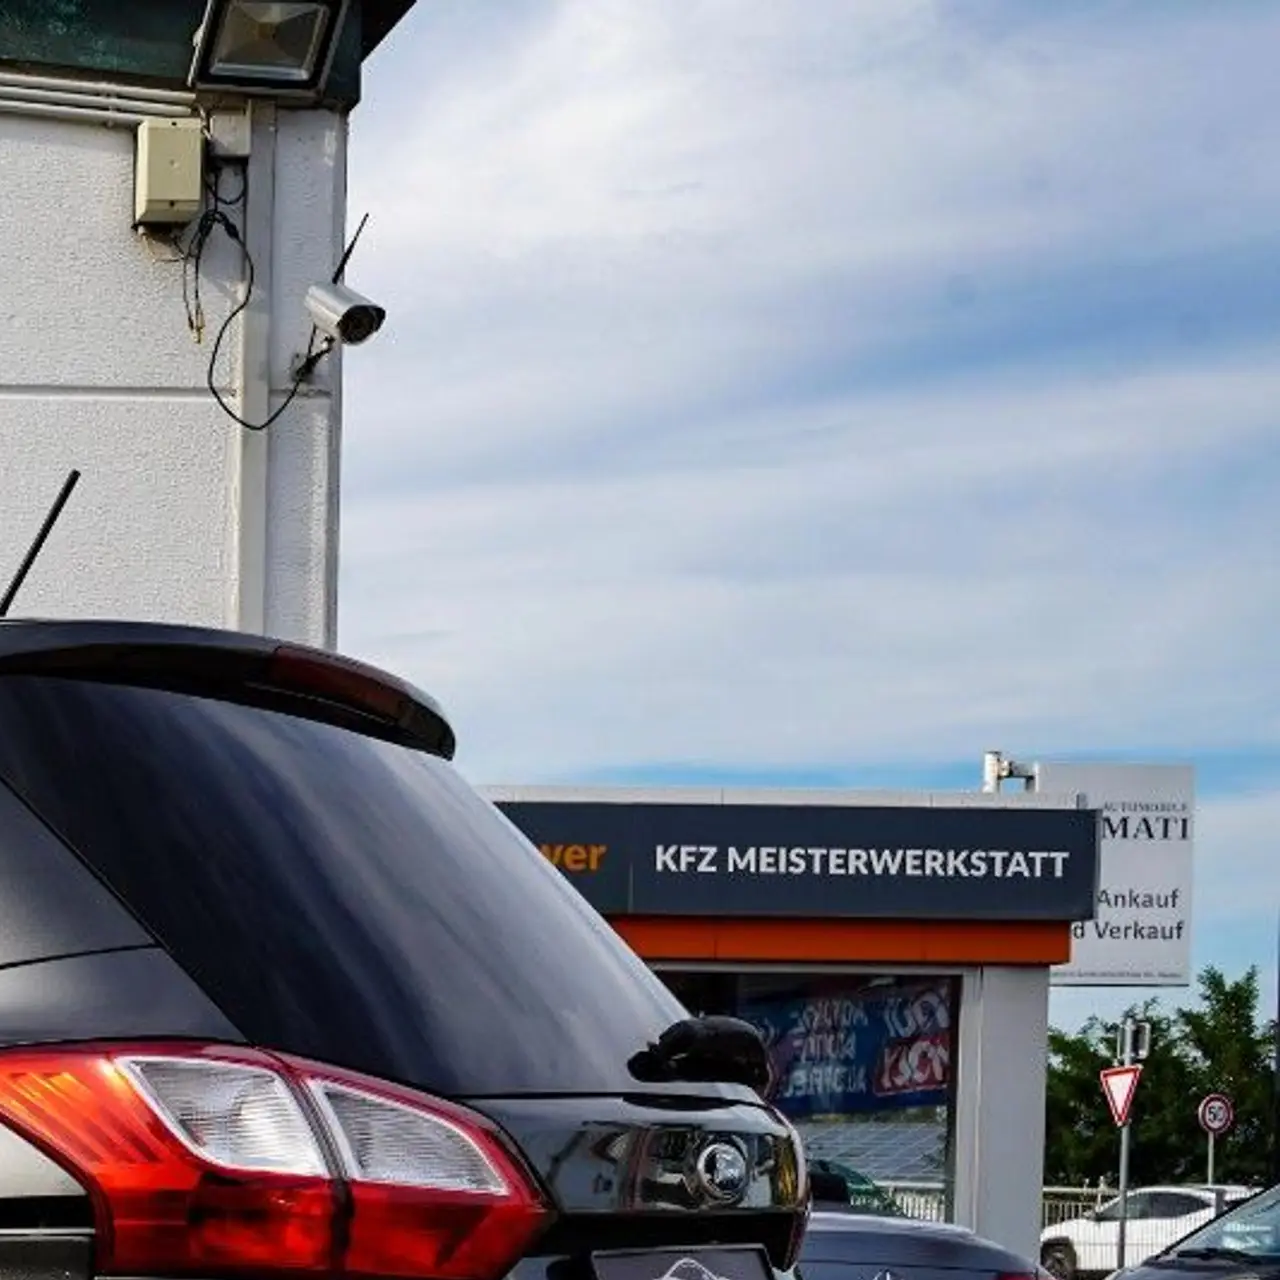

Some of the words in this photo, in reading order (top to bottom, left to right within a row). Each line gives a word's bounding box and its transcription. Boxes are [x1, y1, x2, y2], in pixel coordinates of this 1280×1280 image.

[655, 844, 717, 872] KFZ
[727, 846, 1070, 878] MEISTERWERKSTATT
[1097, 887, 1180, 908] Ankauf
[1094, 920, 1185, 940] Verkauf
